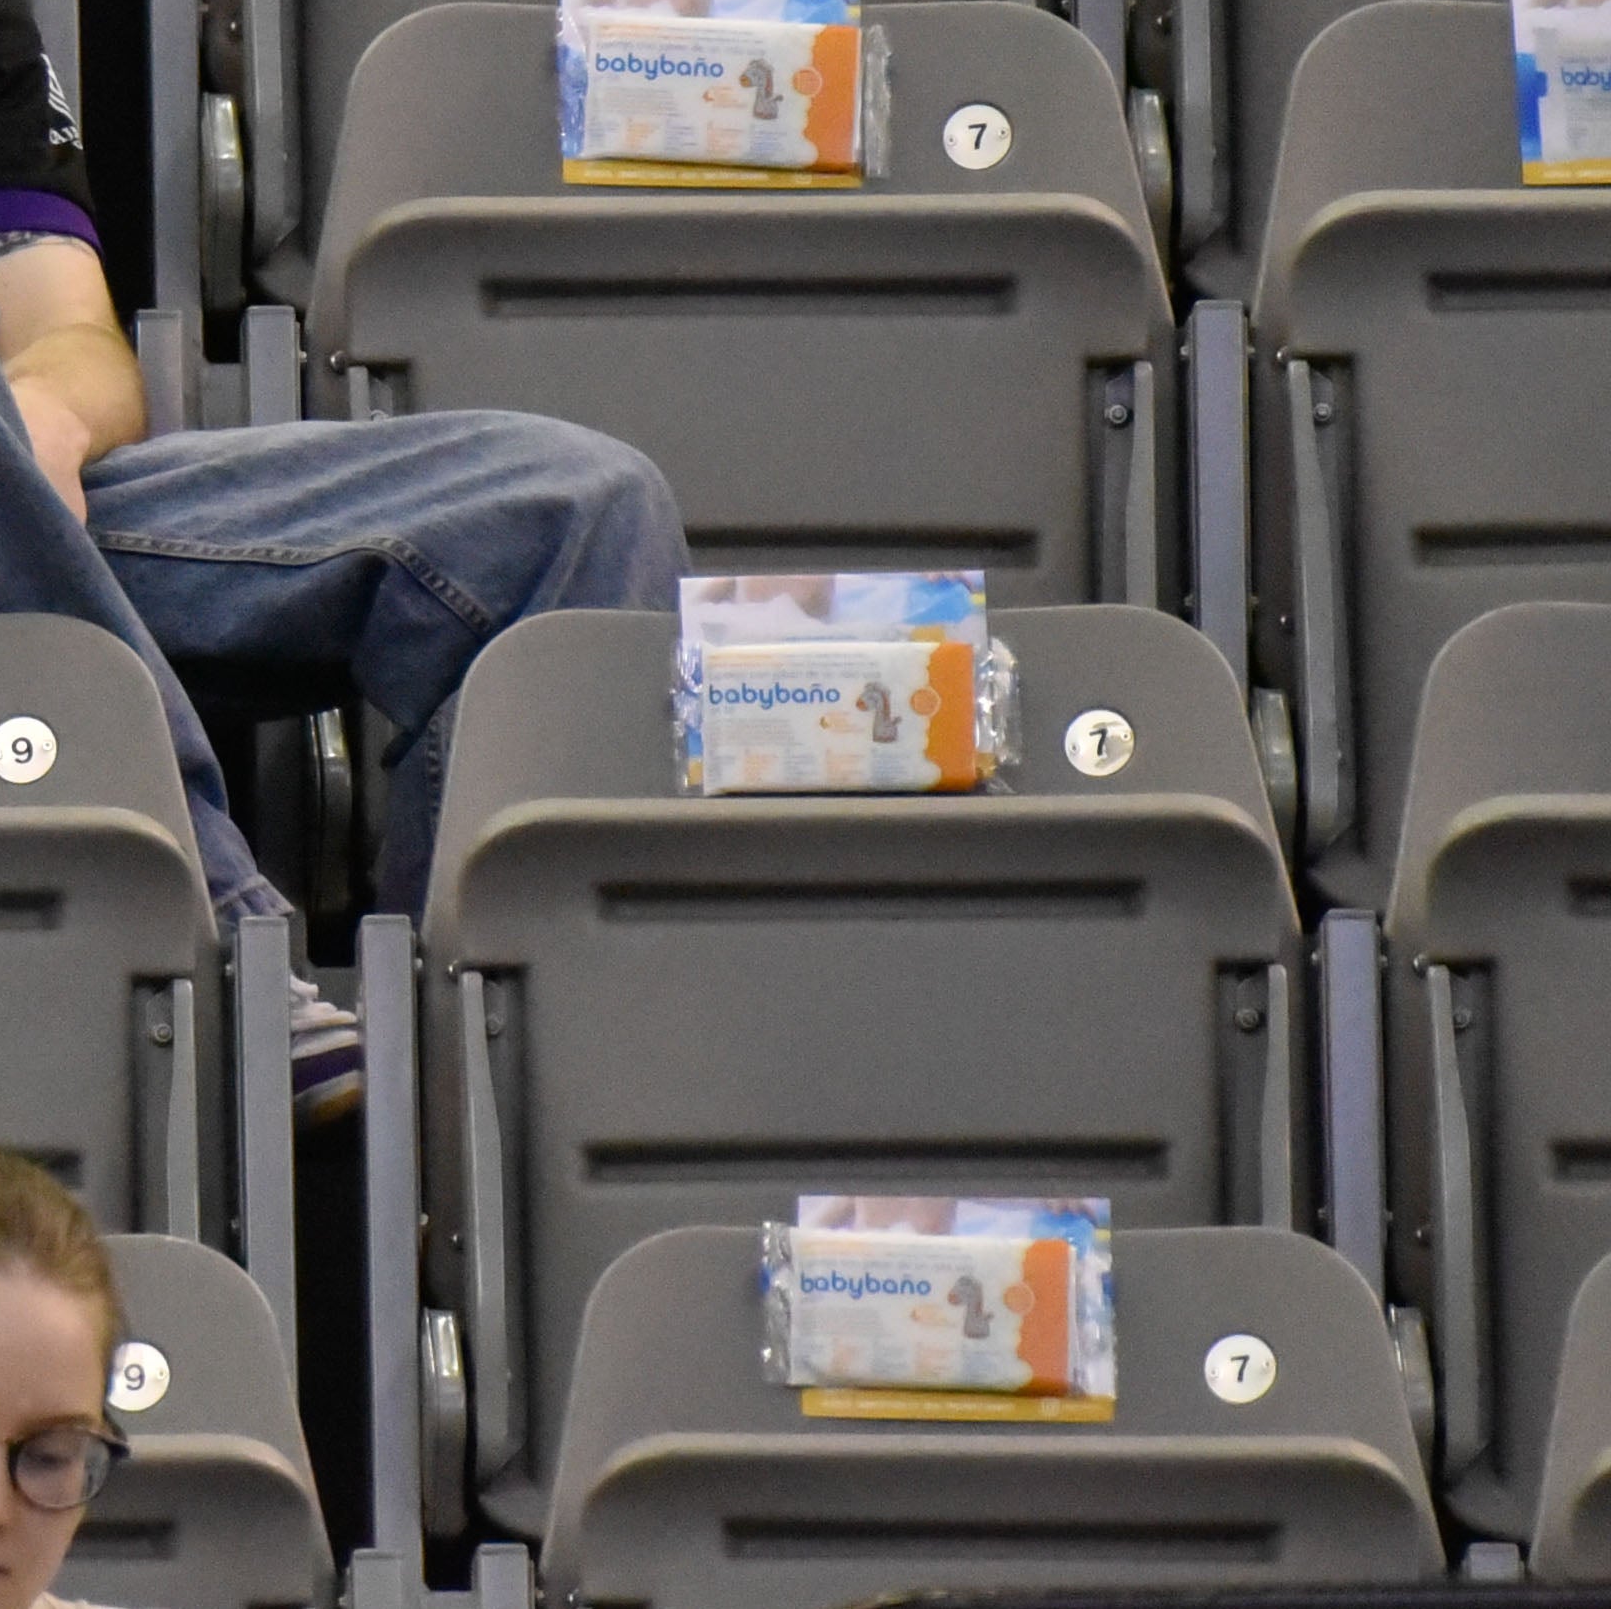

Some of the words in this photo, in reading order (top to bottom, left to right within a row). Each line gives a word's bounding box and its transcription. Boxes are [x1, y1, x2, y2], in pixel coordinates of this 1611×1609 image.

[596, 53, 724, 80] babybaño
[968, 122, 987, 150] 7
[709, 682, 840, 709] babybaño
[11, 737, 33, 764] 9
[1088, 727, 1108, 757] 7
[801, 1271, 931, 1298] babybaño
[124, 1363, 145, 1391] 9
[1230, 1354, 1251, 1382] 7
